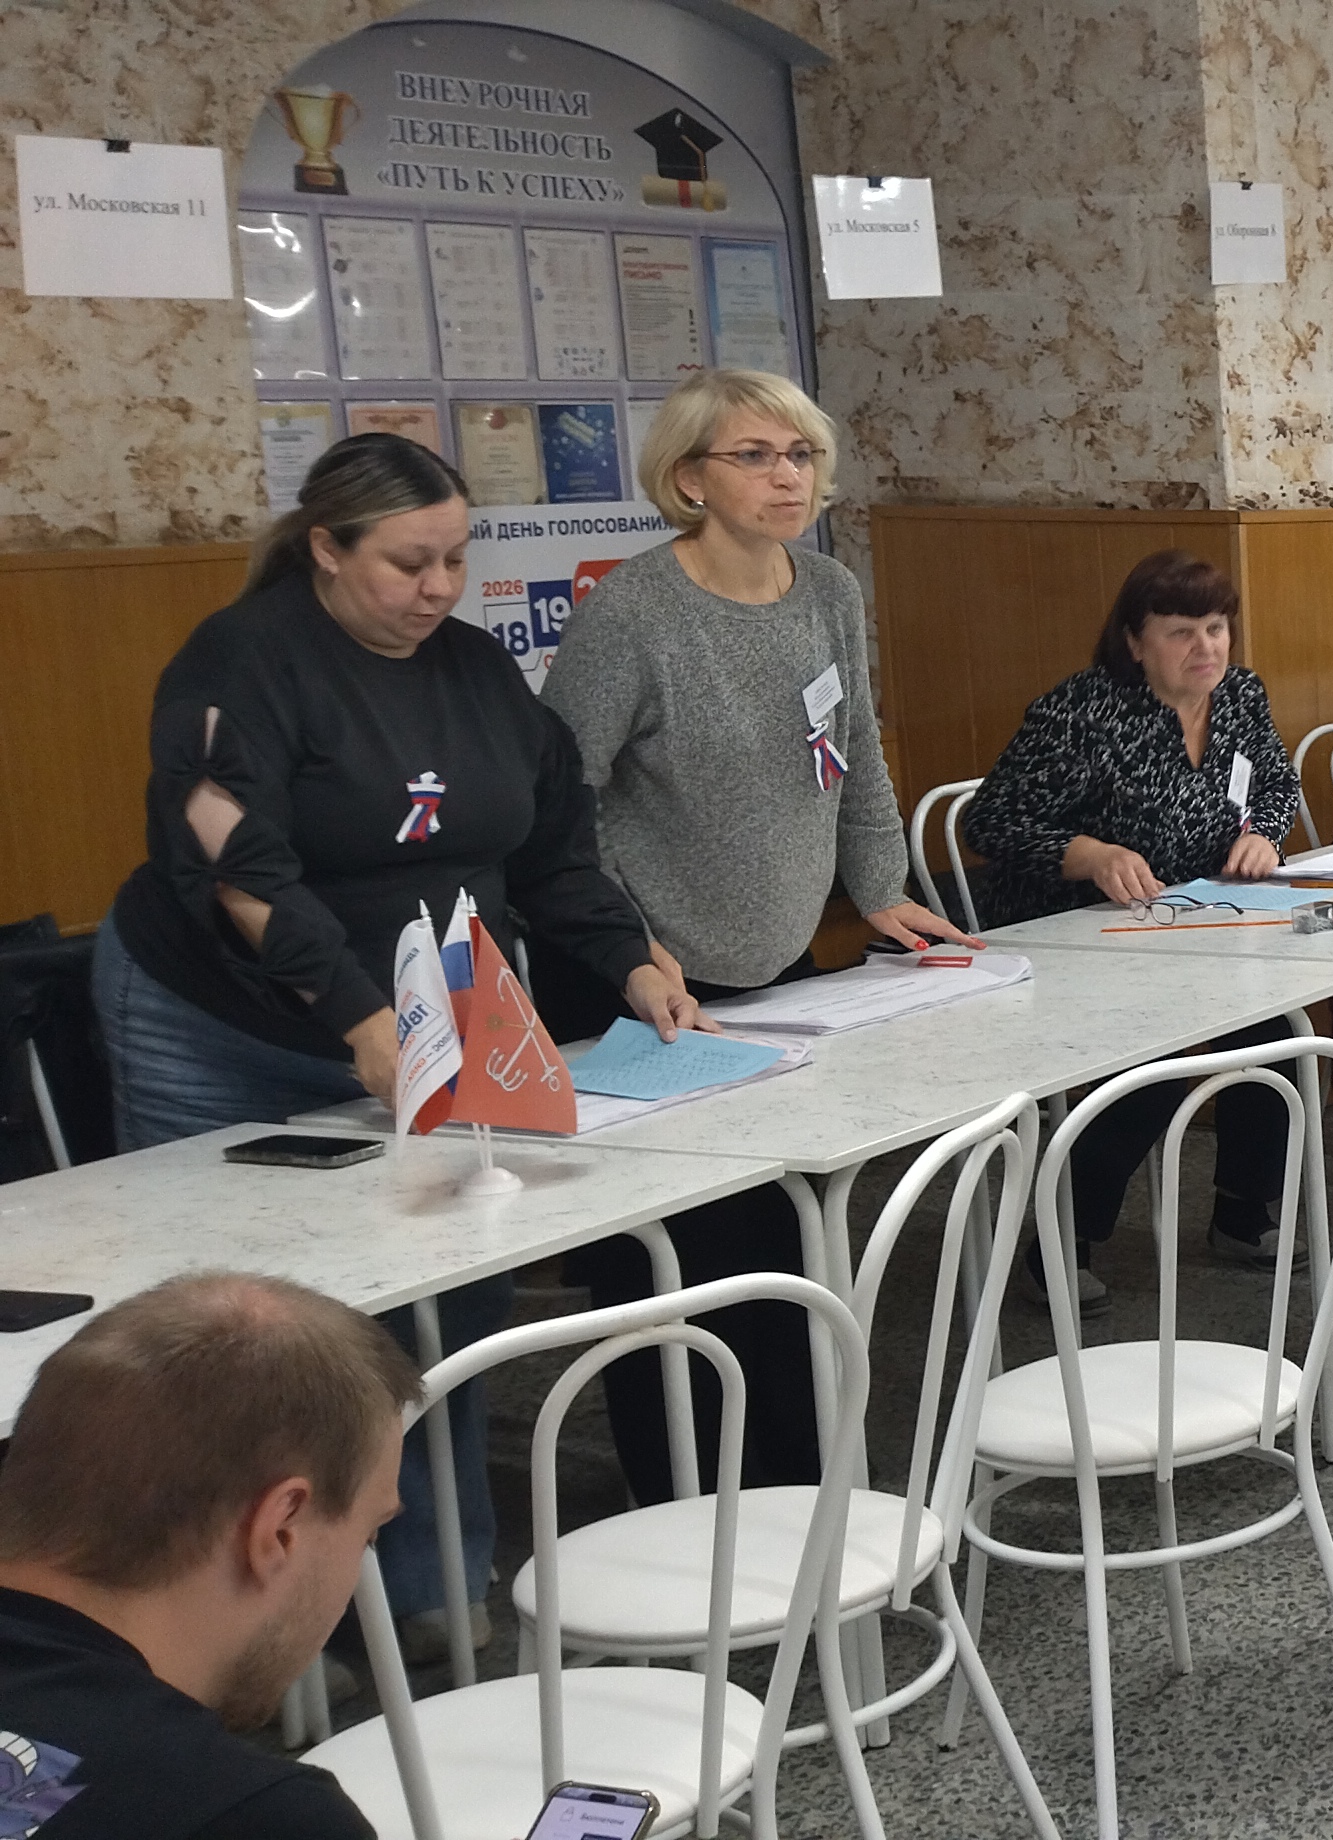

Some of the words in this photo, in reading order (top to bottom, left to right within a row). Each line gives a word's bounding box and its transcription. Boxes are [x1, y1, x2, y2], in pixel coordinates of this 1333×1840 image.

[397, 71, 591, 117] ВНЕУРОЧНАЯ
[389, 117, 613, 161] ДЕЯТЕЛЬНОСТЬ
[377, 162, 469, 192] «ПУТЬ
[477, 169, 496, 195] К
[501, 170, 624, 202] УСПЕХУ»
[33, 195, 61, 213] ул.
[68, 193, 180, 215] Московская
[187, 199, 207, 217] 11
[846, 219, 911, 233] Московская
[497, 520, 544, 541] ДЕНЬ
[482, 580, 524, 598] 2026
[534, 596, 572, 634] 19
[492, 621, 530, 657] 18
